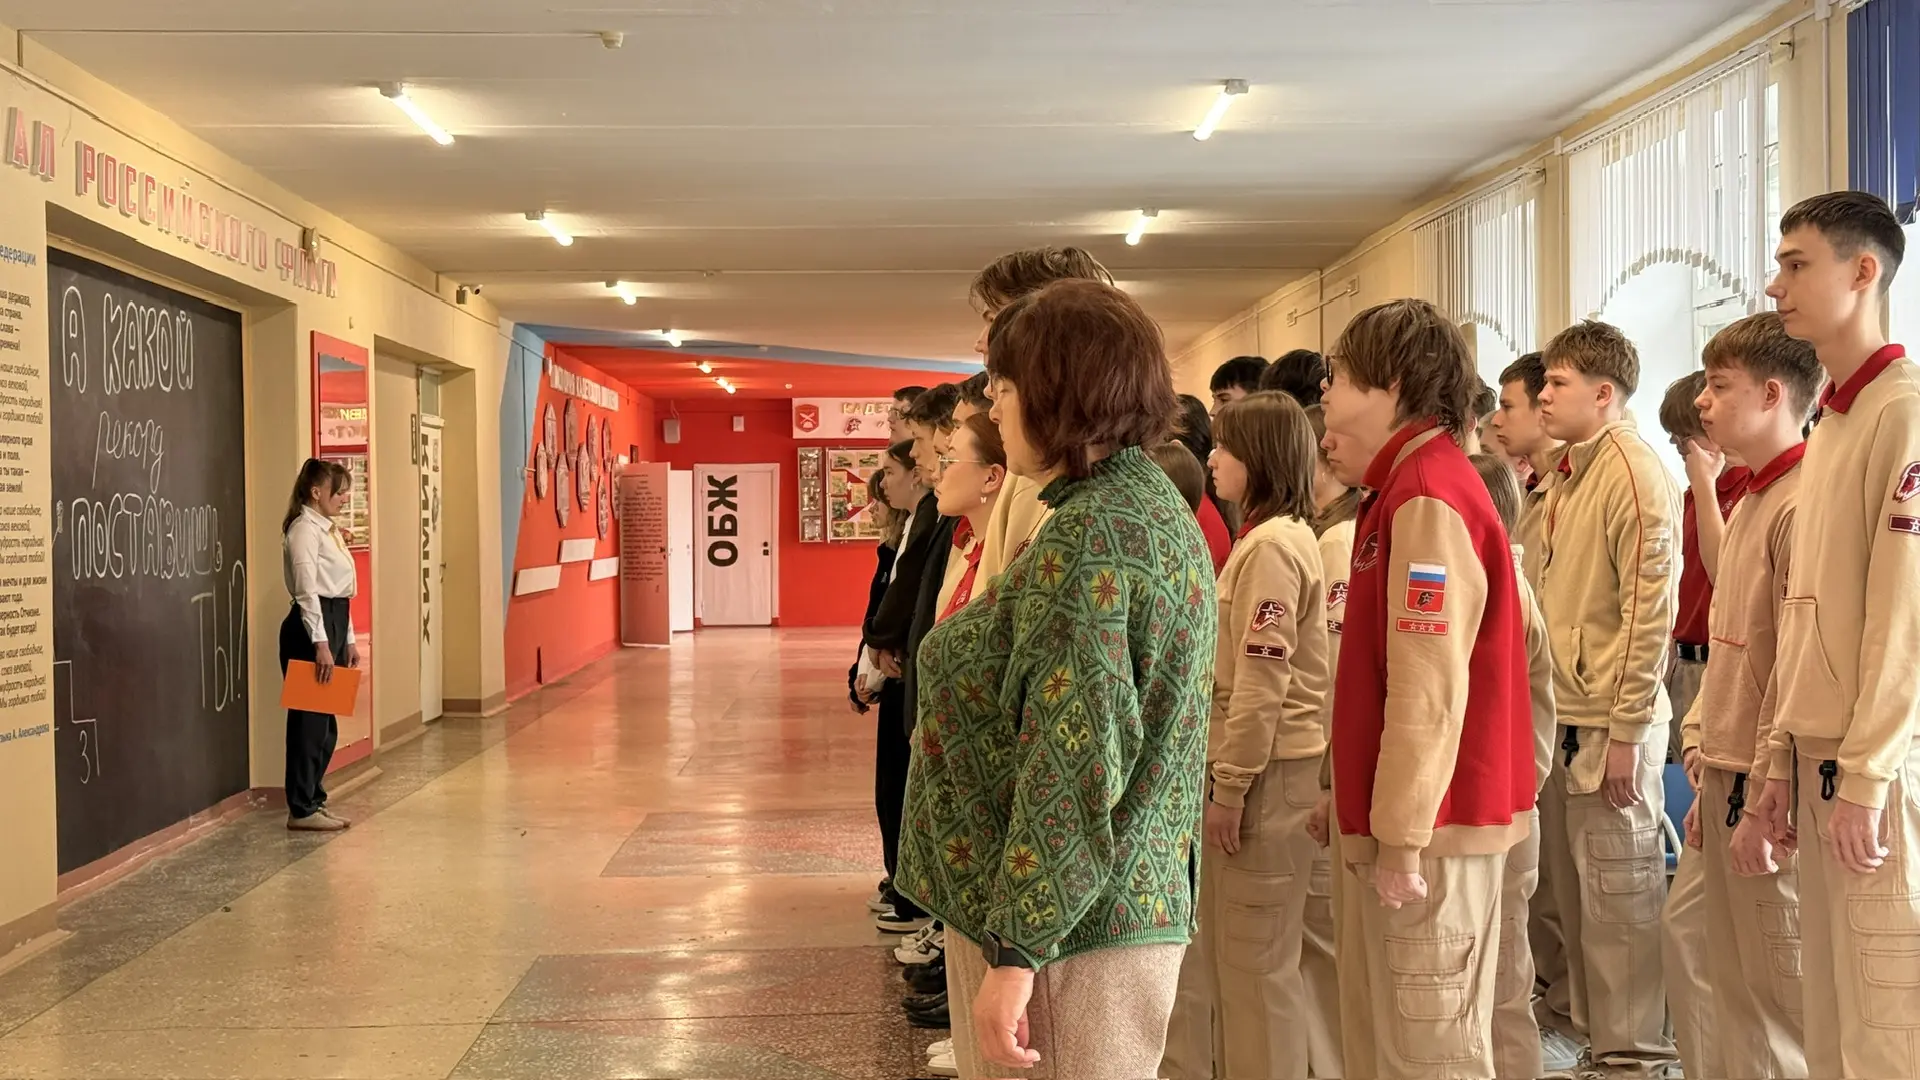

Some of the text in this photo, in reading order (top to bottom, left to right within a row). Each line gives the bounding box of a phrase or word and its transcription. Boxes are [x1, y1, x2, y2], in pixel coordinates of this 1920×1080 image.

[0, 245, 36, 267] едерации
[76, 140, 267, 271] РОССИЙСКОГО
[62, 286, 194, 395] А КАКОЙ
[421, 432, 431, 647] ХИМИЯ
[707, 474, 738, 567] ОБЖ
